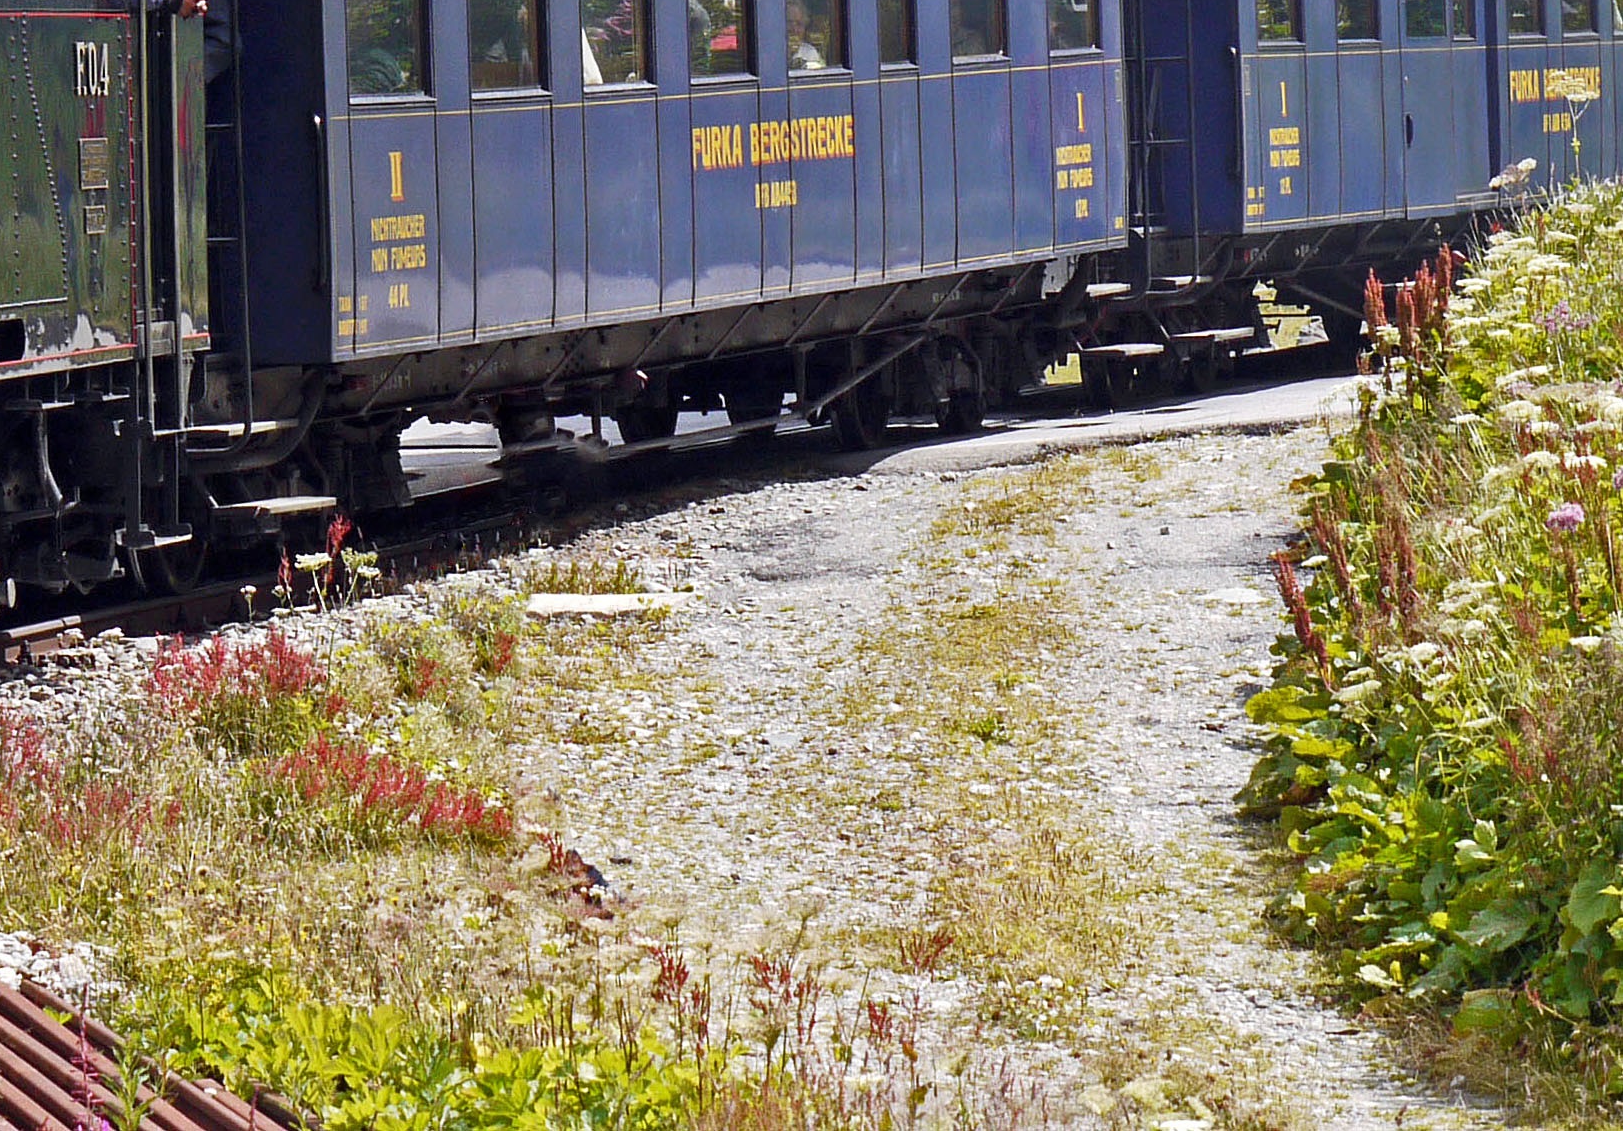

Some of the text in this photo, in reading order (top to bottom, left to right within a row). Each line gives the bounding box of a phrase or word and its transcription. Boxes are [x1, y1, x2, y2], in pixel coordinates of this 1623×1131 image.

[1510, 69, 1540, 102] FURKA
[692, 115, 855, 171] FURKA BERGSTRECKE
[371, 215, 426, 242] NICHTRAUCHER
[371, 248, 388, 273] NON
